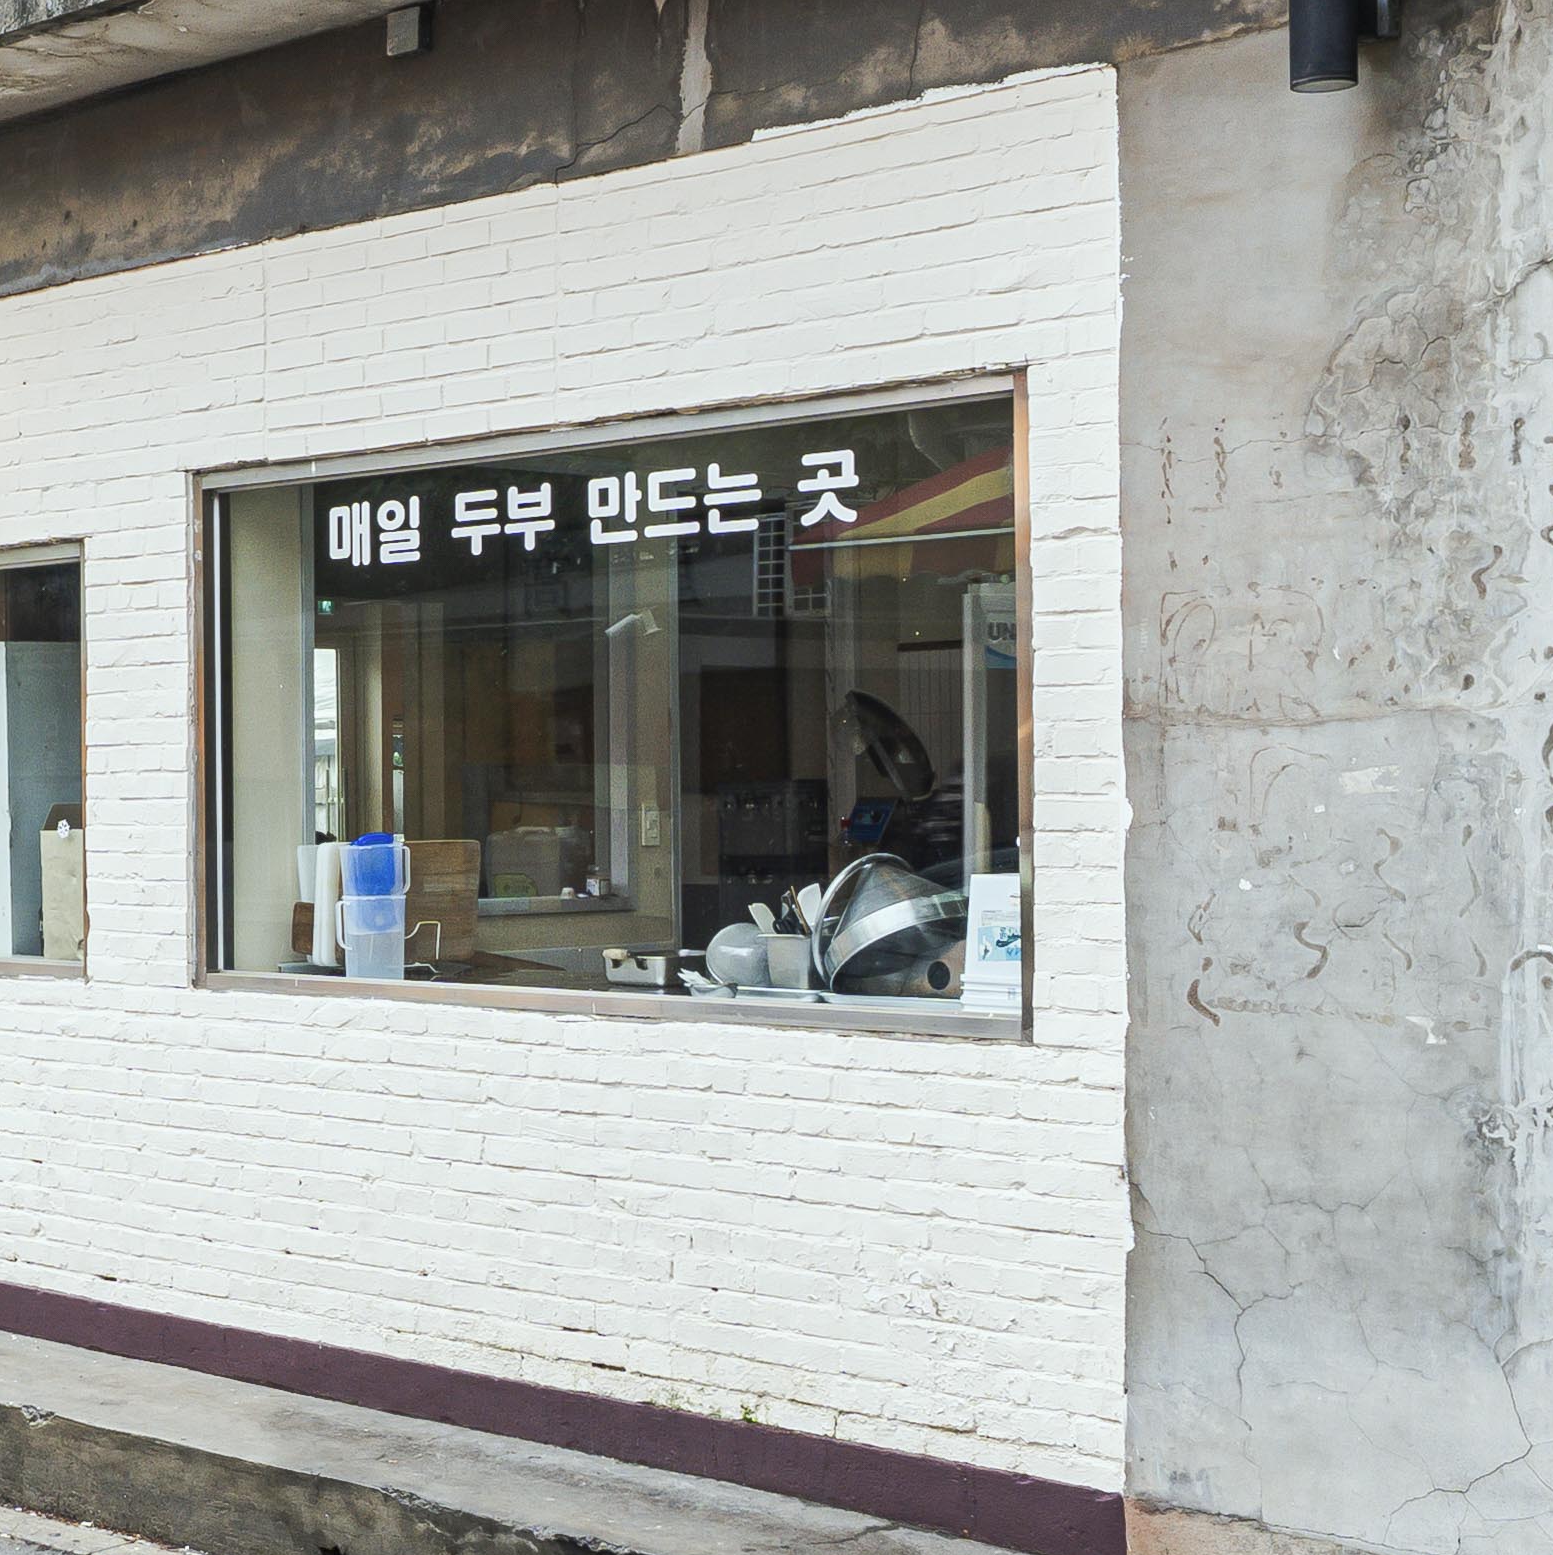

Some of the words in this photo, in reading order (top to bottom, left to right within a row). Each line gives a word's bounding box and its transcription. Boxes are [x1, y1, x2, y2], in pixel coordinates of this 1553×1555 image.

[328, 495, 423, 569] 매일
[450, 484, 555, 557] 두부
[587, 462, 761, 547] 만드는
[796, 449, 860, 527] 곳
